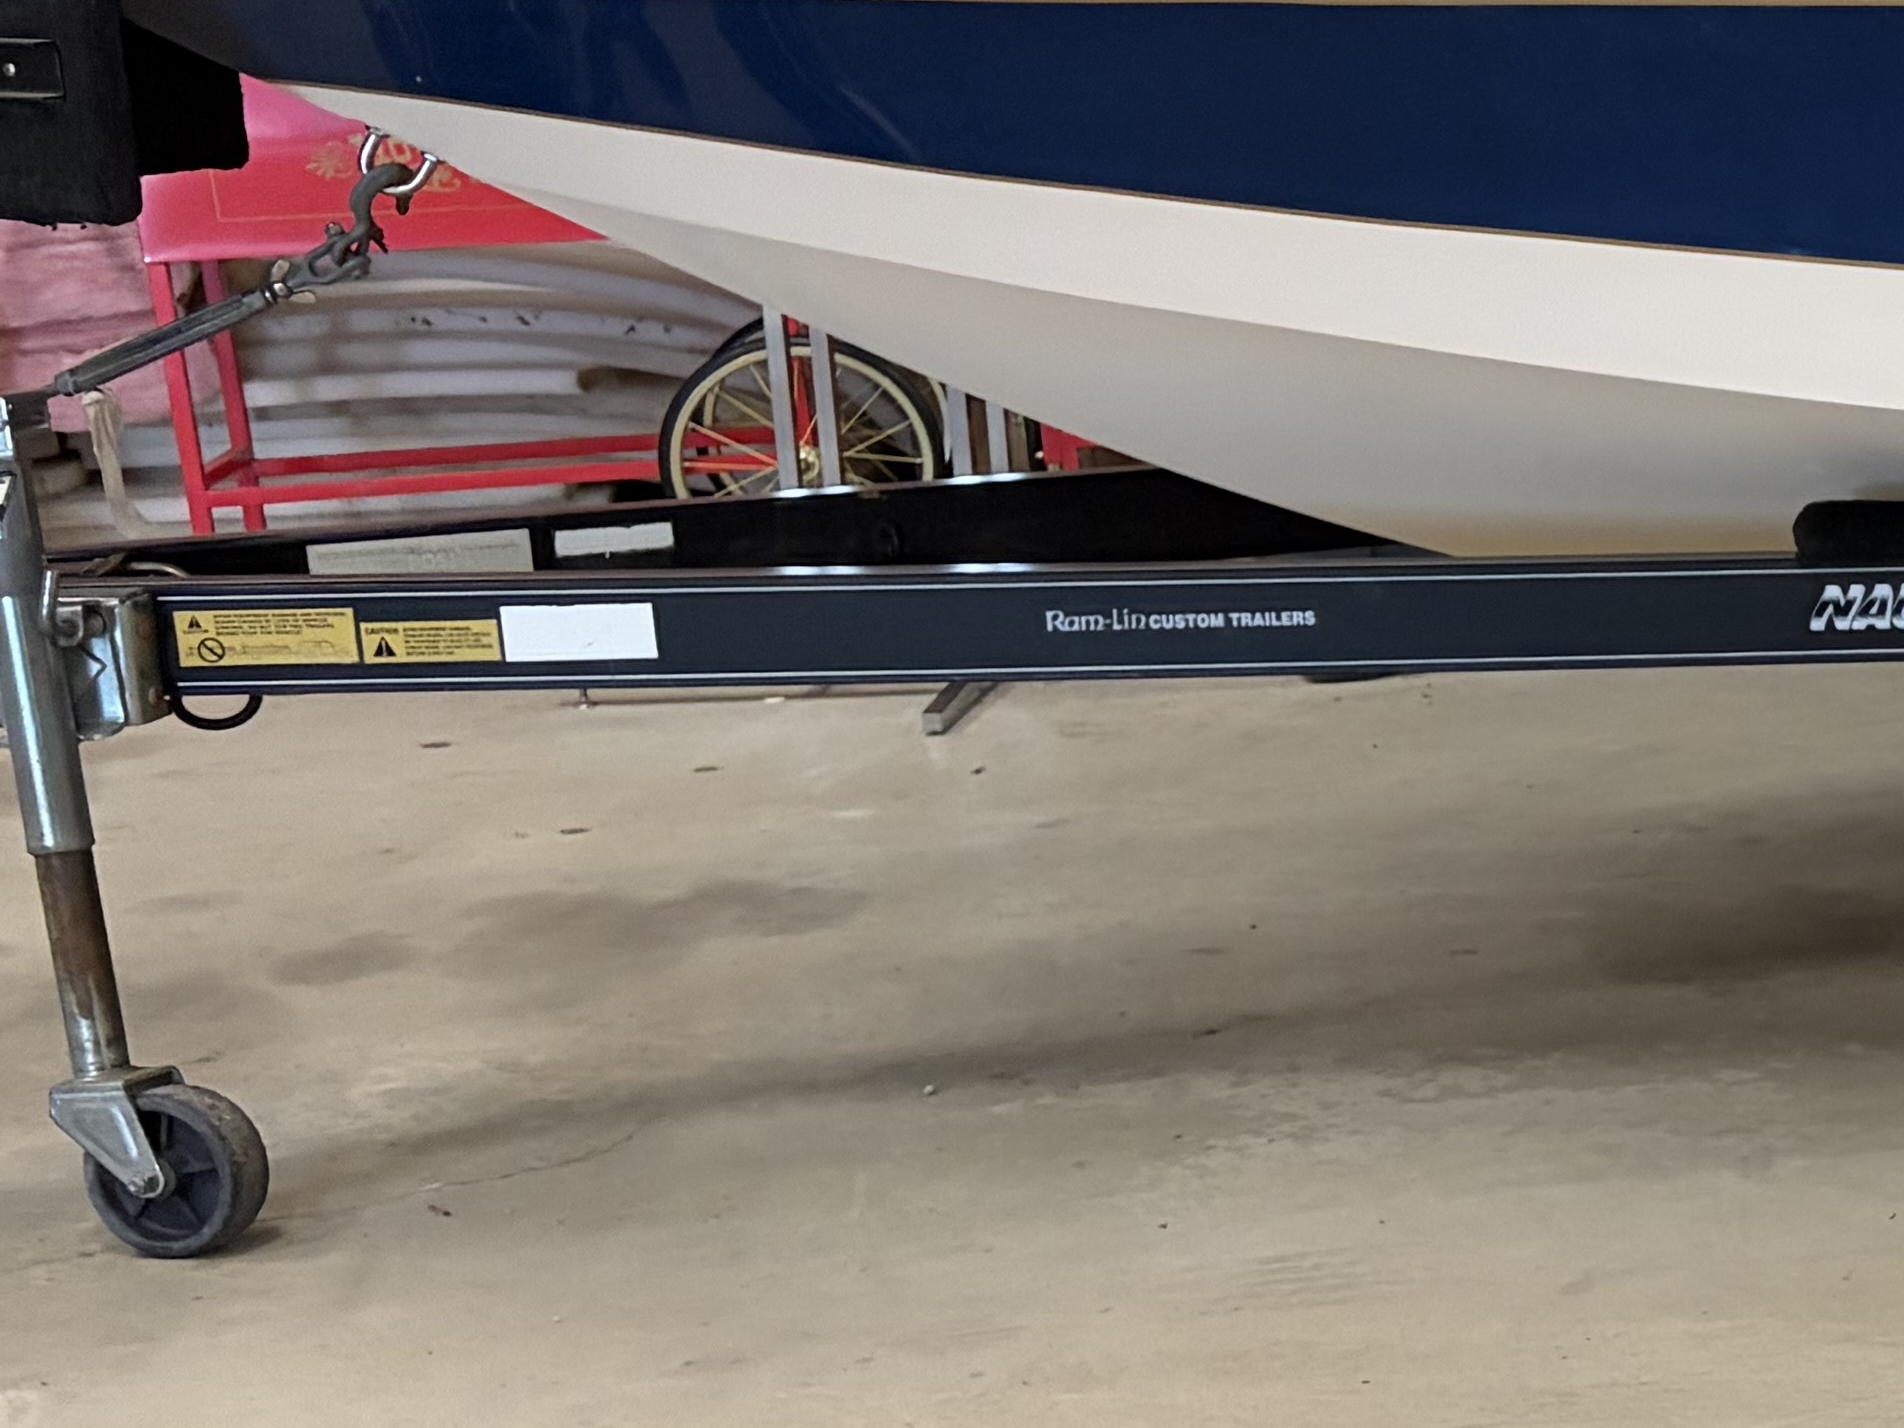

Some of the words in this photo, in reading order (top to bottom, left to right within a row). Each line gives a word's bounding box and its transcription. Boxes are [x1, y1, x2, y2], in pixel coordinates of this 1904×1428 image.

[1045, 608, 1147, 633] Ram-Lin
[1149, 612, 1225, 630] CUSTOM
[1229, 610, 1317, 629] TRAILERS
